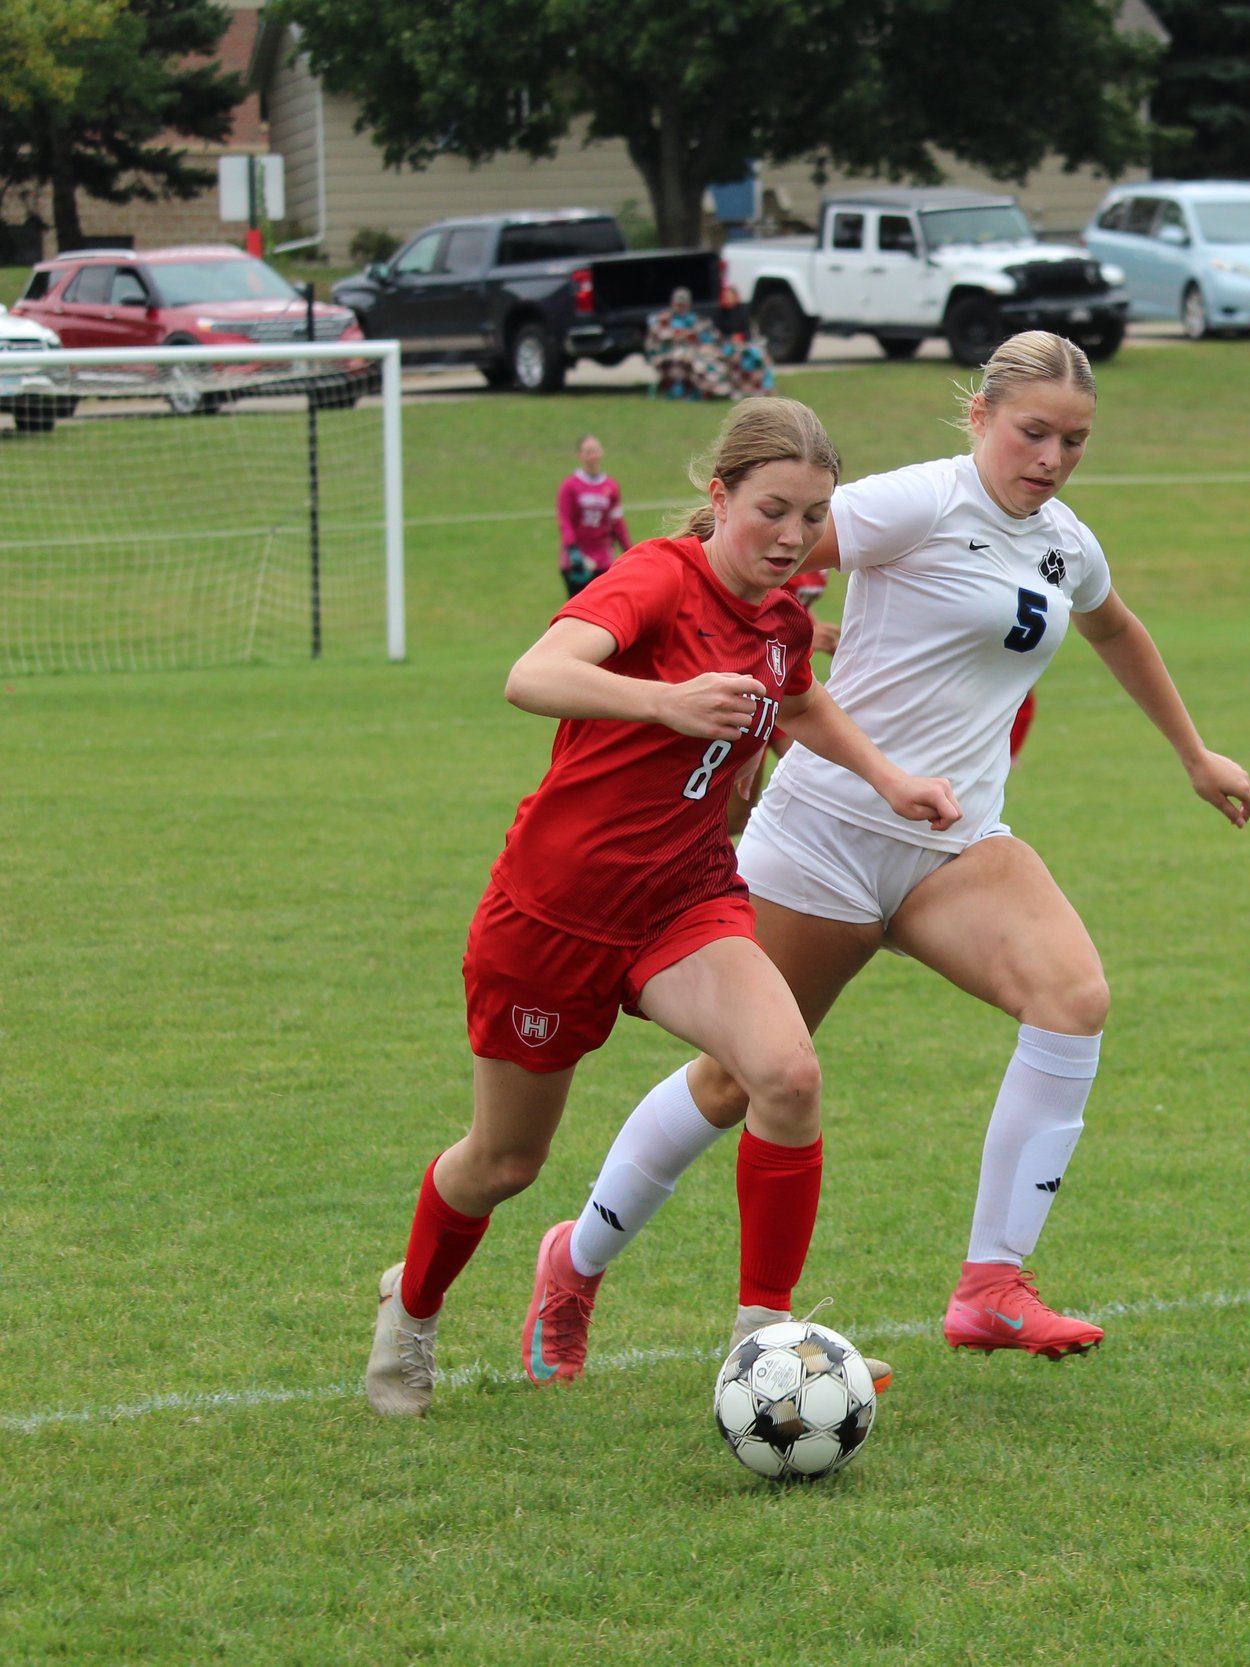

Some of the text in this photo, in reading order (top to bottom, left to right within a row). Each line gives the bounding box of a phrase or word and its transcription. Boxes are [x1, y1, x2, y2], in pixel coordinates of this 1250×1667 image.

[1004, 587, 1048, 653] 5
[682, 738, 733, 801] 8
[521, 1012, 549, 1039] H
